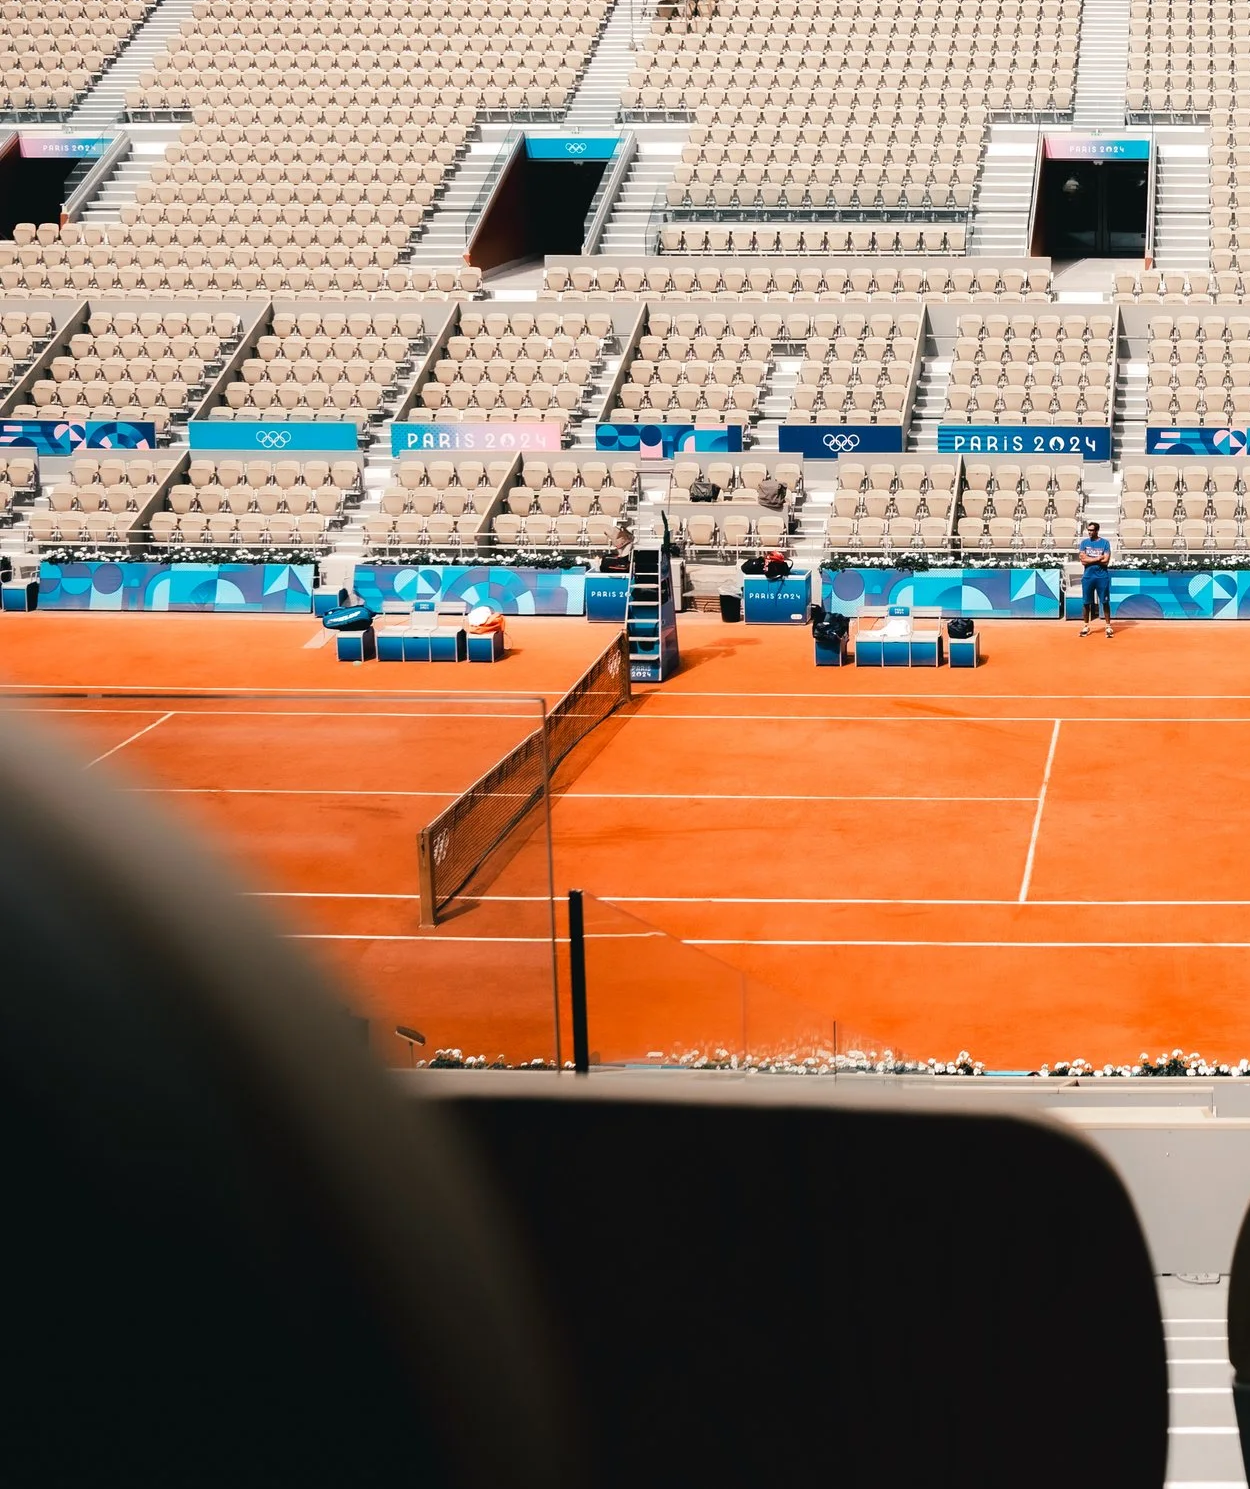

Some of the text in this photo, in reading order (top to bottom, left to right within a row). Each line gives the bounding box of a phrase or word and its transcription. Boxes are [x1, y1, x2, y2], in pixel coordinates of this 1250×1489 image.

[1100, 145, 1125, 153] 2024
[485, 433, 546, 449] 2024
[1033, 436, 1096, 452] 2024
